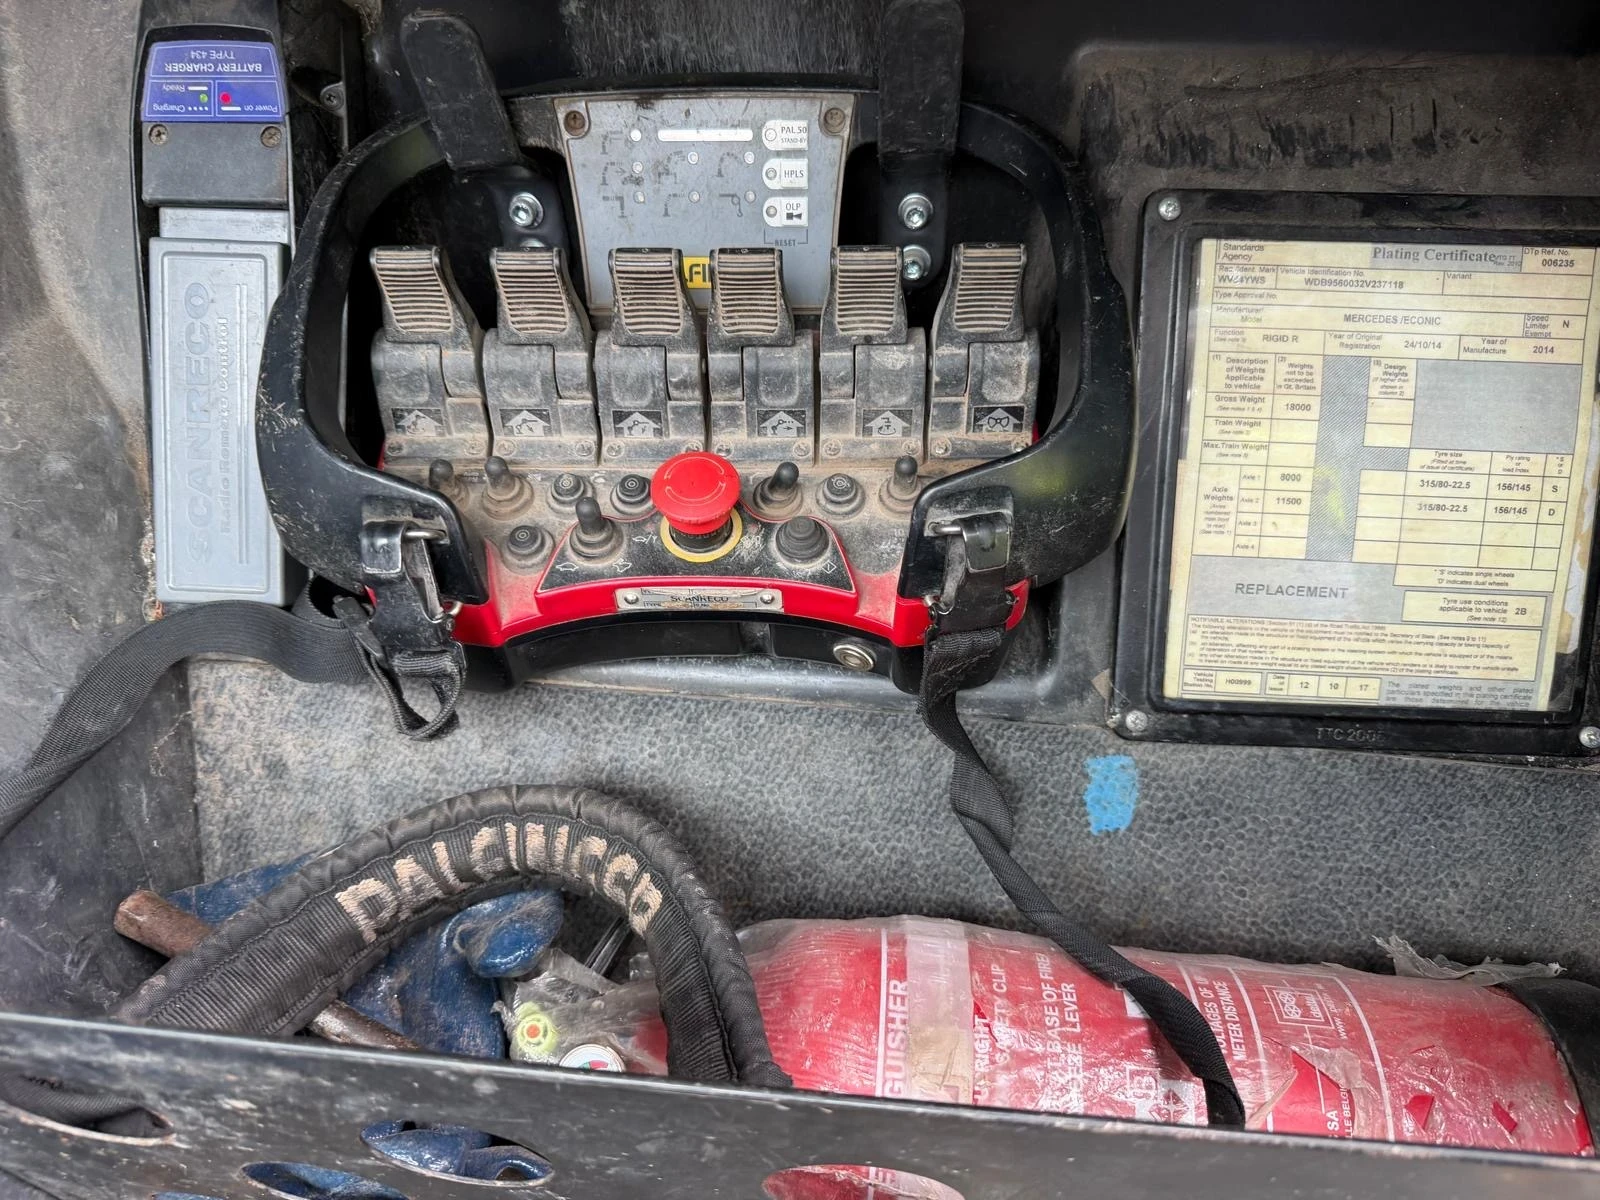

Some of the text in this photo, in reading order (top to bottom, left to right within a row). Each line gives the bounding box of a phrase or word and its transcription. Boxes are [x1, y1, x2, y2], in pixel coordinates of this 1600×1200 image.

[190, 50, 235, 59] TYPE 434
[164, 62, 262, 72] BATTERY CHARGER
[163, 84, 185, 93] Ready
[153, 103, 186, 112] Charging
[254, 104, 277, 112] Power
[784, 169, 804, 179] HPLS
[785, 202, 801, 212] OLP
[774, 239, 797, 247] RESET
[1223, 242, 1265, 252] Standards
[1373, 246, 1420, 262] Plating
[1424, 248, 1496, 263] Certificate
[1541, 248, 1557, 256] Ref.
[1222, 252, 1253, 262] Agency
[1541, 259, 1575, 268] 006235
[1258, 265, 1276, 273] Mark
[1280, 267, 1306, 275] Vehicle
[1308, 268, 1352, 277] Identification
[1446, 271, 1472, 280] Variant
[1215, 290, 1232, 299] Type
[1343, 314, 1441, 326] MERCEDES /ECONIC
[1526, 314, 1549, 323] Speed
[1525, 322, 1550, 330] Limiter
[1562, 320, 1569, 328] N
[1214, 328, 1244, 336] Function
[1524, 330, 1551, 338] Exempt
[1262, 334, 1298, 343] RIGID R
[1355, 332, 1382, 342] Original
[1481, 337, 1498, 345] Year
[1339, 342, 1381, 351] Registration
[1404, 339, 1442, 350] 24/10/14
[1463, 346, 1507, 355] Manufacture
[1533, 345, 1554, 354] 2014
[217, 317, 230, 392] Control
[1225, 356, 1269, 365] Description
[1287, 362, 1314, 370] Weights
[1384, 363, 1407, 371] Design
[1235, 367, 1266, 375] Weights
[1225, 374, 1264, 382] Applicable
[1214, 394, 1265, 404] Gross Weight
[1286, 403, 1312, 412] 18000
[183, 281, 213, 564] SCANRECO
[1214, 419, 1262, 428] Train Weight
[1241, 443, 1268, 451] Weight
[1434, 451, 1449, 459] Tyre
[1280, 473, 1302, 482] 8000
[1419, 479, 1471, 489] 315/80-22.5
[1497, 482, 1531, 491] 156/145
[1551, 485, 1558, 493] S
[1203, 494, 1234, 502] Weights
[1276, 497, 1302, 506] 11500
[218, 477, 231, 535] Radio
[1417, 503, 1468, 513] 315/80-22.5
[1493, 506, 1528, 515] 156/145
[1548, 508, 1555, 516] D
[1475, 571, 1493, 579] single
[1446, 578, 1472, 586] indicates
[1234, 583, 1349, 599] REPLACEMENT
[1442, 597, 1458, 605] Tyre
[1473, 599, 1509, 607] conditions
[1439, 605, 1473, 613] applicable
[1514, 607, 1527, 615] 2B
[1299, 681, 1310, 689] 12
[1437, 684, 1463, 692] weights
[1315, 727, 1344, 741] TTC
[990, 963, 1008, 993] CLIP
[1041, 983, 1058, 1002] OF
[1200, 986, 1214, 998] OF
[1213, 980, 1240, 1021] DISTANCE
[1061, 982, 1081, 1034] LEVER
[1044, 1005, 1060, 1054] BASE
[1228, 1023, 1246, 1061] METER
[973, 1012, 990, 1101] URIGHT
[1327, 1109, 1339, 1131] SA
